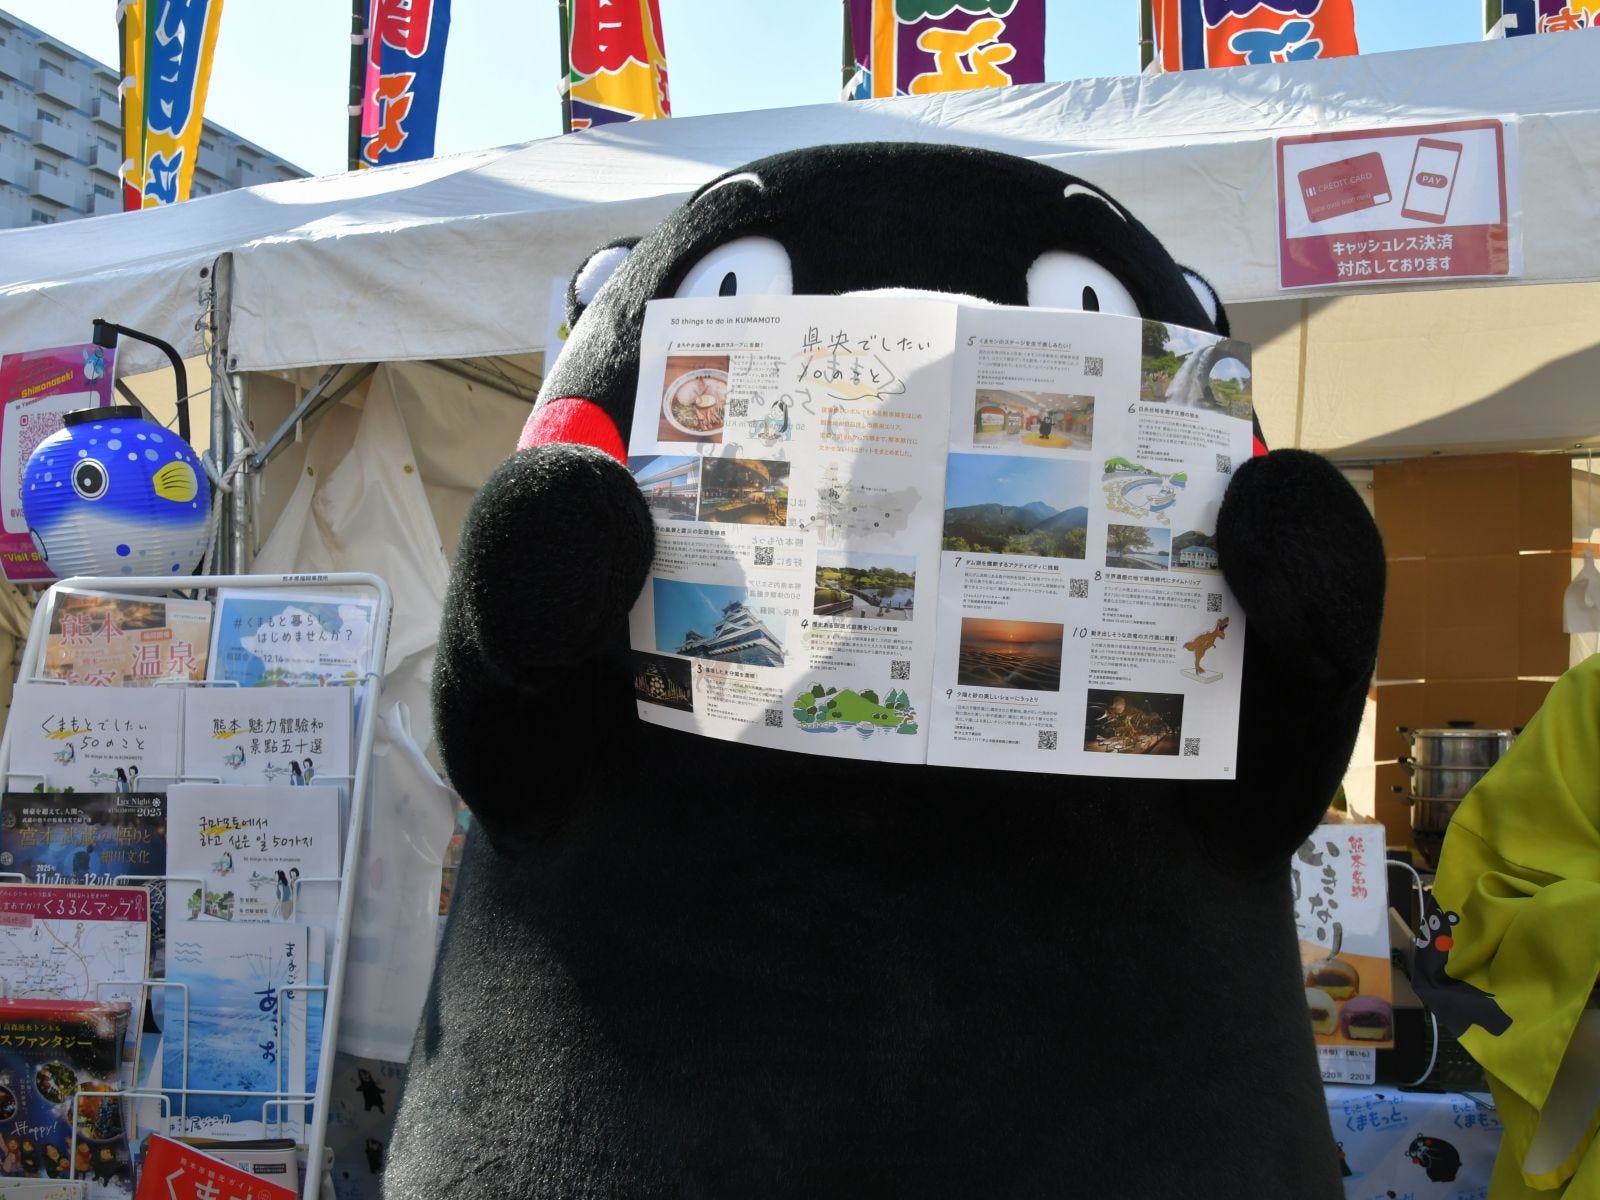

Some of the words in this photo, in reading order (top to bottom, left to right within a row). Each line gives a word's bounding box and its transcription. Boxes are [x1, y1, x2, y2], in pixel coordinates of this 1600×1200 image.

[1317, 176, 1348, 193] CREDIT
[1350, 171, 1373, 186] CARD
[1421, 175, 1442, 186] PAY
[1332, 233, 1454, 256] キャッシュレス決済
[1337, 256, 1452, 277] 対応しております
[671, 318, 680, 326] 50
[681, 317, 704, 327] things
[706, 317, 714, 325] to
[715, 317, 725, 325] do
[726, 317, 734, 325] in
[735, 316, 781, 325] KUMAMOTO
[802, 325, 931, 354] 県央でしたい
[967, 336, 976, 346] 5
[1128, 403, 1136, 414] 6
[954, 557, 962, 567] 7
[1094, 571, 1102, 581] 8
[59, 613, 125, 646] 熊本
[800, 619, 809, 630] 4
[257, 629, 353, 643] はじめませんか?
[1073, 627, 1088, 639] 10
[131, 641, 197, 678] 温泉
[696, 664, 703, 675] 3
[945, 688, 953, 700] 9
[41, 715, 148, 734] くまもとでしたい
[213, 718, 242, 735] 熊本
[248, 717, 325, 735] 魅力體驗和
[80, 737, 146, 751] 50のこと
[250, 738, 323, 755] 景點五十選
[137, 808, 162, 818] 2025
[199, 816, 268, 832] 구마모토에서
[199, 832, 223, 848] 하고
[229, 834, 250, 851] 싶은
[256, 833, 269, 853] 일
[273, 835, 313, 849] 50가지
[1348, 835, 1368, 899] 熊本名物
[284, 941, 297, 1000] まるごと
[11, 1121, 58, 1142] Happy!
